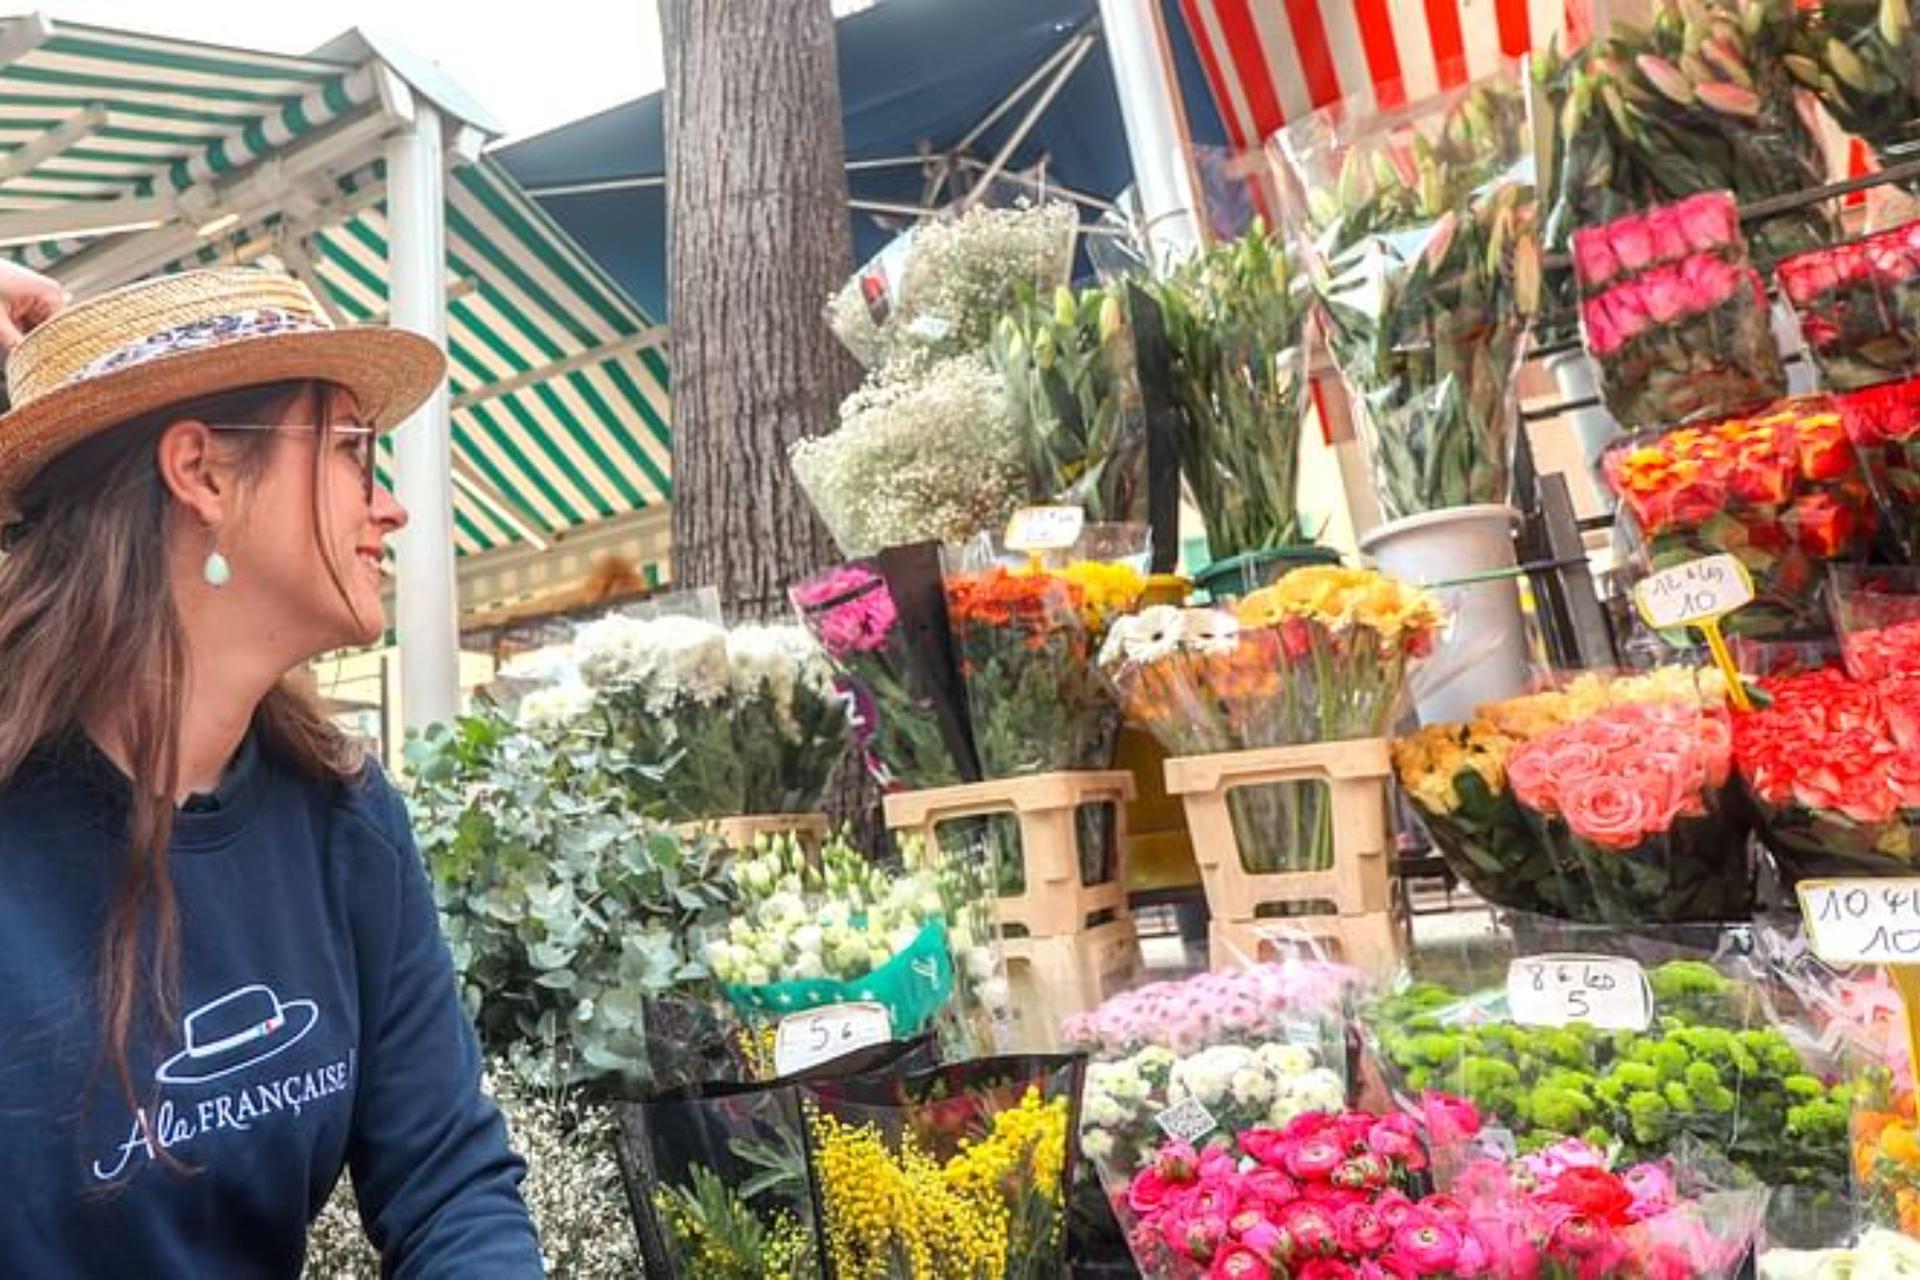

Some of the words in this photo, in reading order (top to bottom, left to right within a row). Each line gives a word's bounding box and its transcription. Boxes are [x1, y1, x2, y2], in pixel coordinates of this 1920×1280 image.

[1679, 591, 1718, 618] 10
[1820, 887, 1869, 921] 10
[1526, 963, 1544, 991] 8
[1567, 989, 1590, 1017] 5
[809, 1018, 830, 1052] 5
[157, 1100, 198, 1148] la
